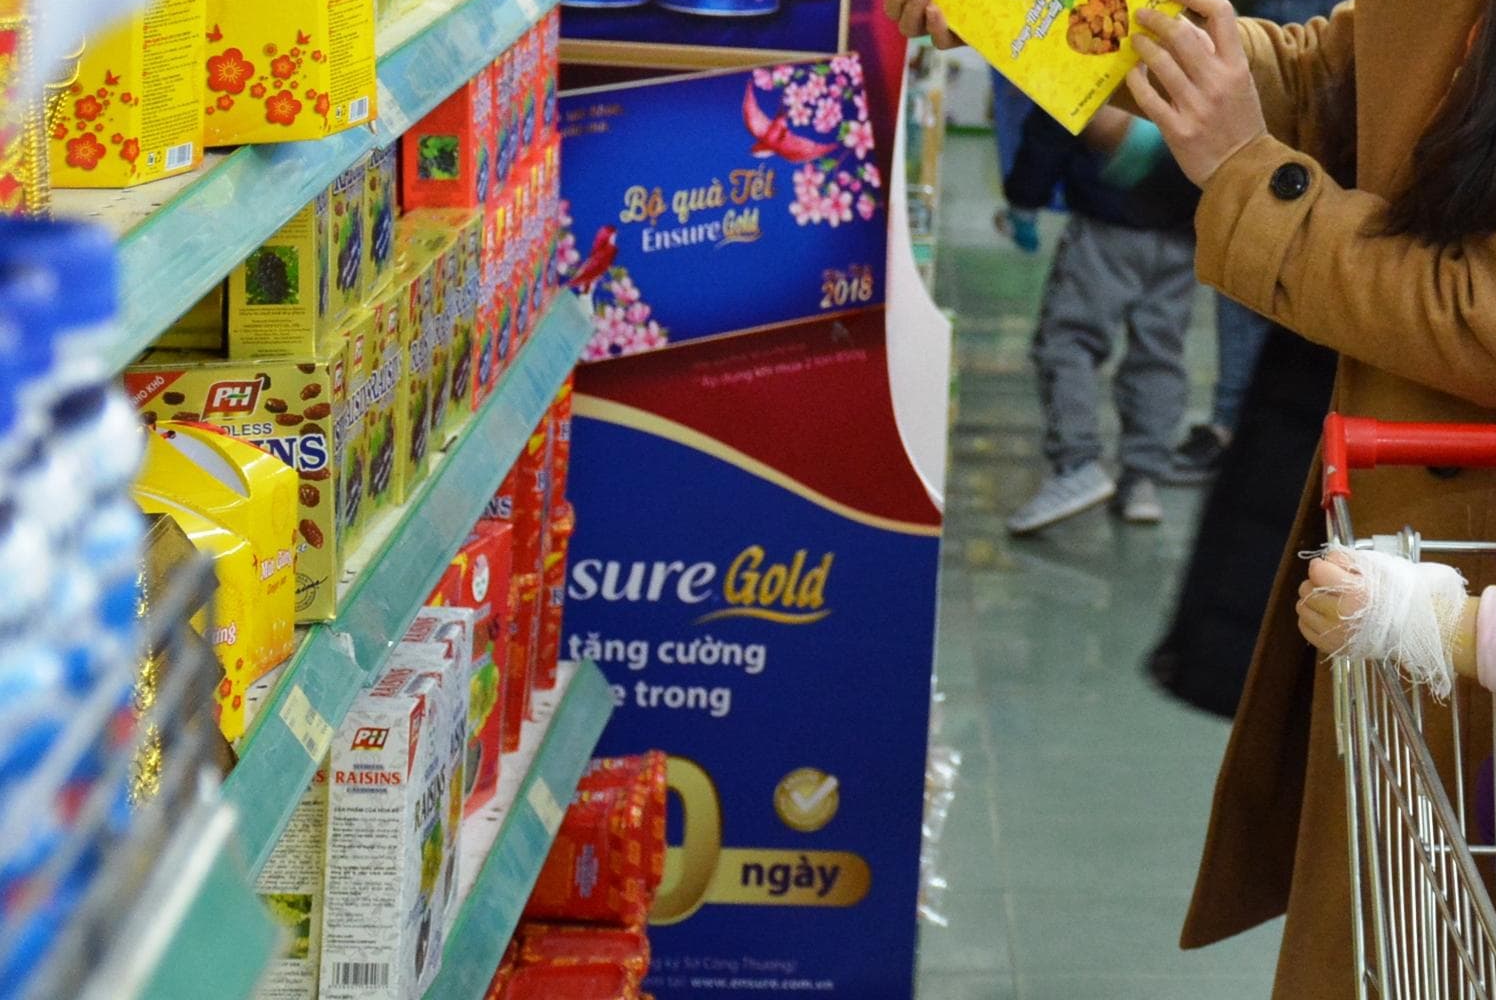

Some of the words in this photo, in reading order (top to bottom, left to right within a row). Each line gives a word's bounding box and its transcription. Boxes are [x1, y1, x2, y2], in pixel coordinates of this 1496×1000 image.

[672, 176, 725, 225] quà
[641, 221, 721, 253] Ensure
[819, 272, 874, 309] 2018
[226, 422, 273, 437] DLESS
[722, 544, 835, 608] Gold
[567, 631, 650, 671] tăng
[657, 634, 768, 676] cường
[633, 680, 732, 718] trong
[335, 770, 402, 786] RAISINS
[740, 855, 841, 897] ngày
